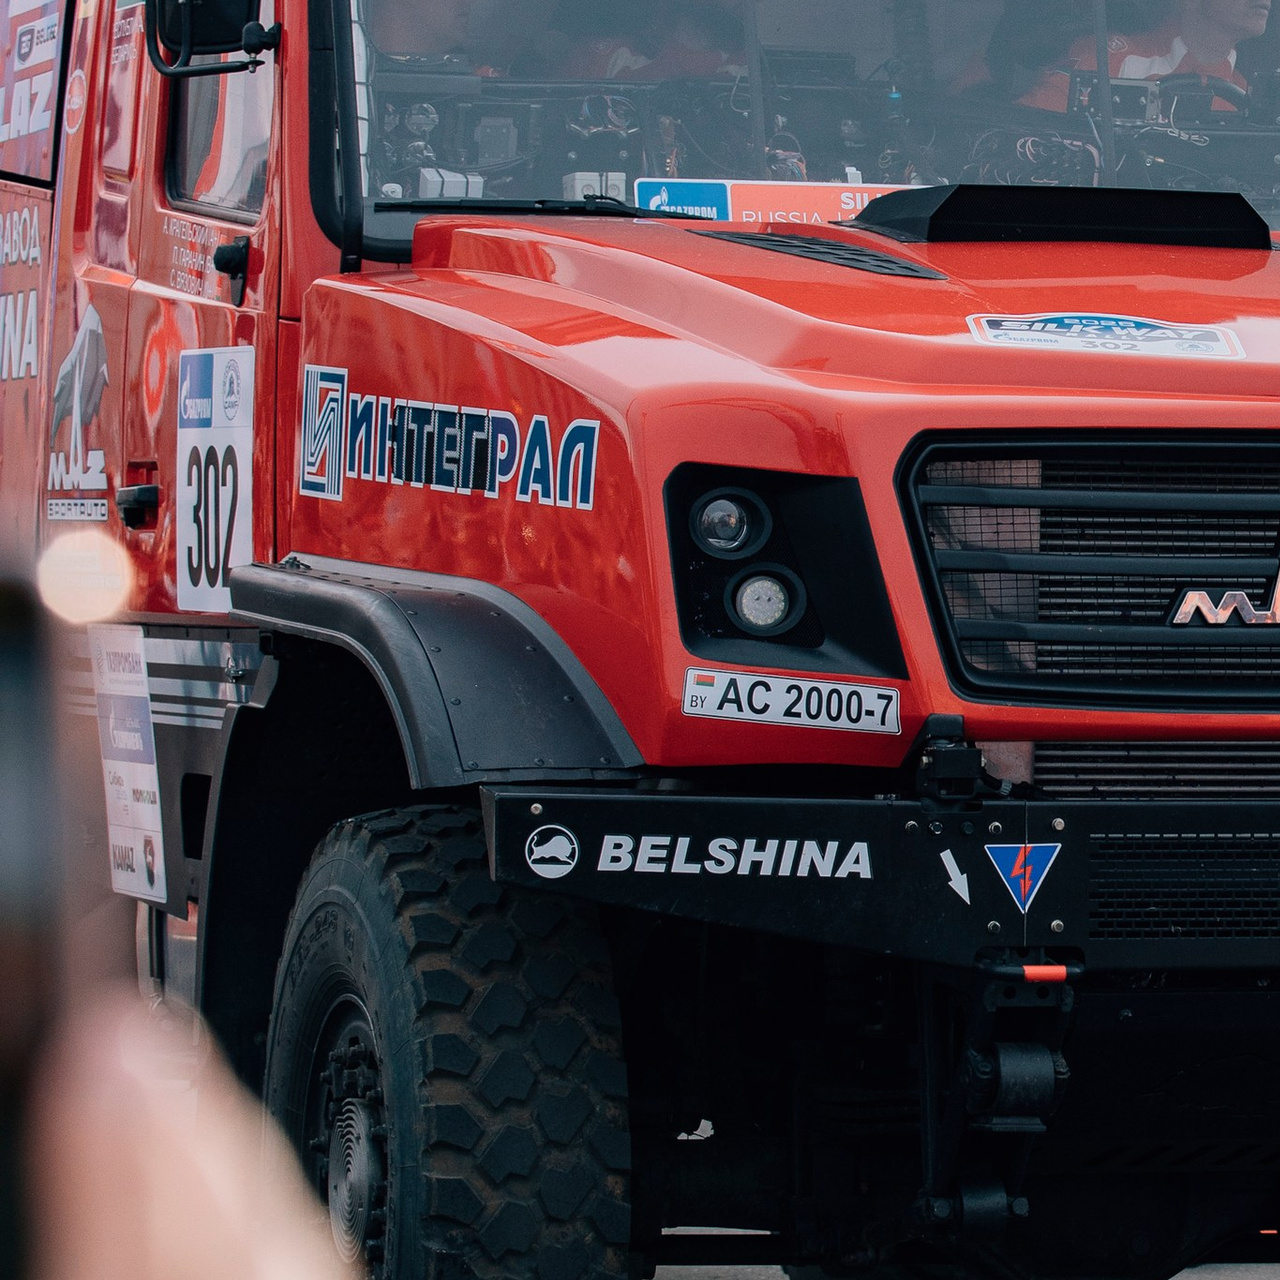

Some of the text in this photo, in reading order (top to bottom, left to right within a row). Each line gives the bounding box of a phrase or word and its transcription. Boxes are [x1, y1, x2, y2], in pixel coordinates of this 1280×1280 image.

[0, 206, 41, 266] АВОД
[1000, 320, 1205, 340] SILK WAY
[1080, 340, 1142, 352] 302
[346, 392, 601, 511] ИНТЕГРАЛ
[187, 444, 239, 588] 302
[690, 677, 894, 726] BY AC 2000-7
[597, 834, 874, 879] BELSHINA
